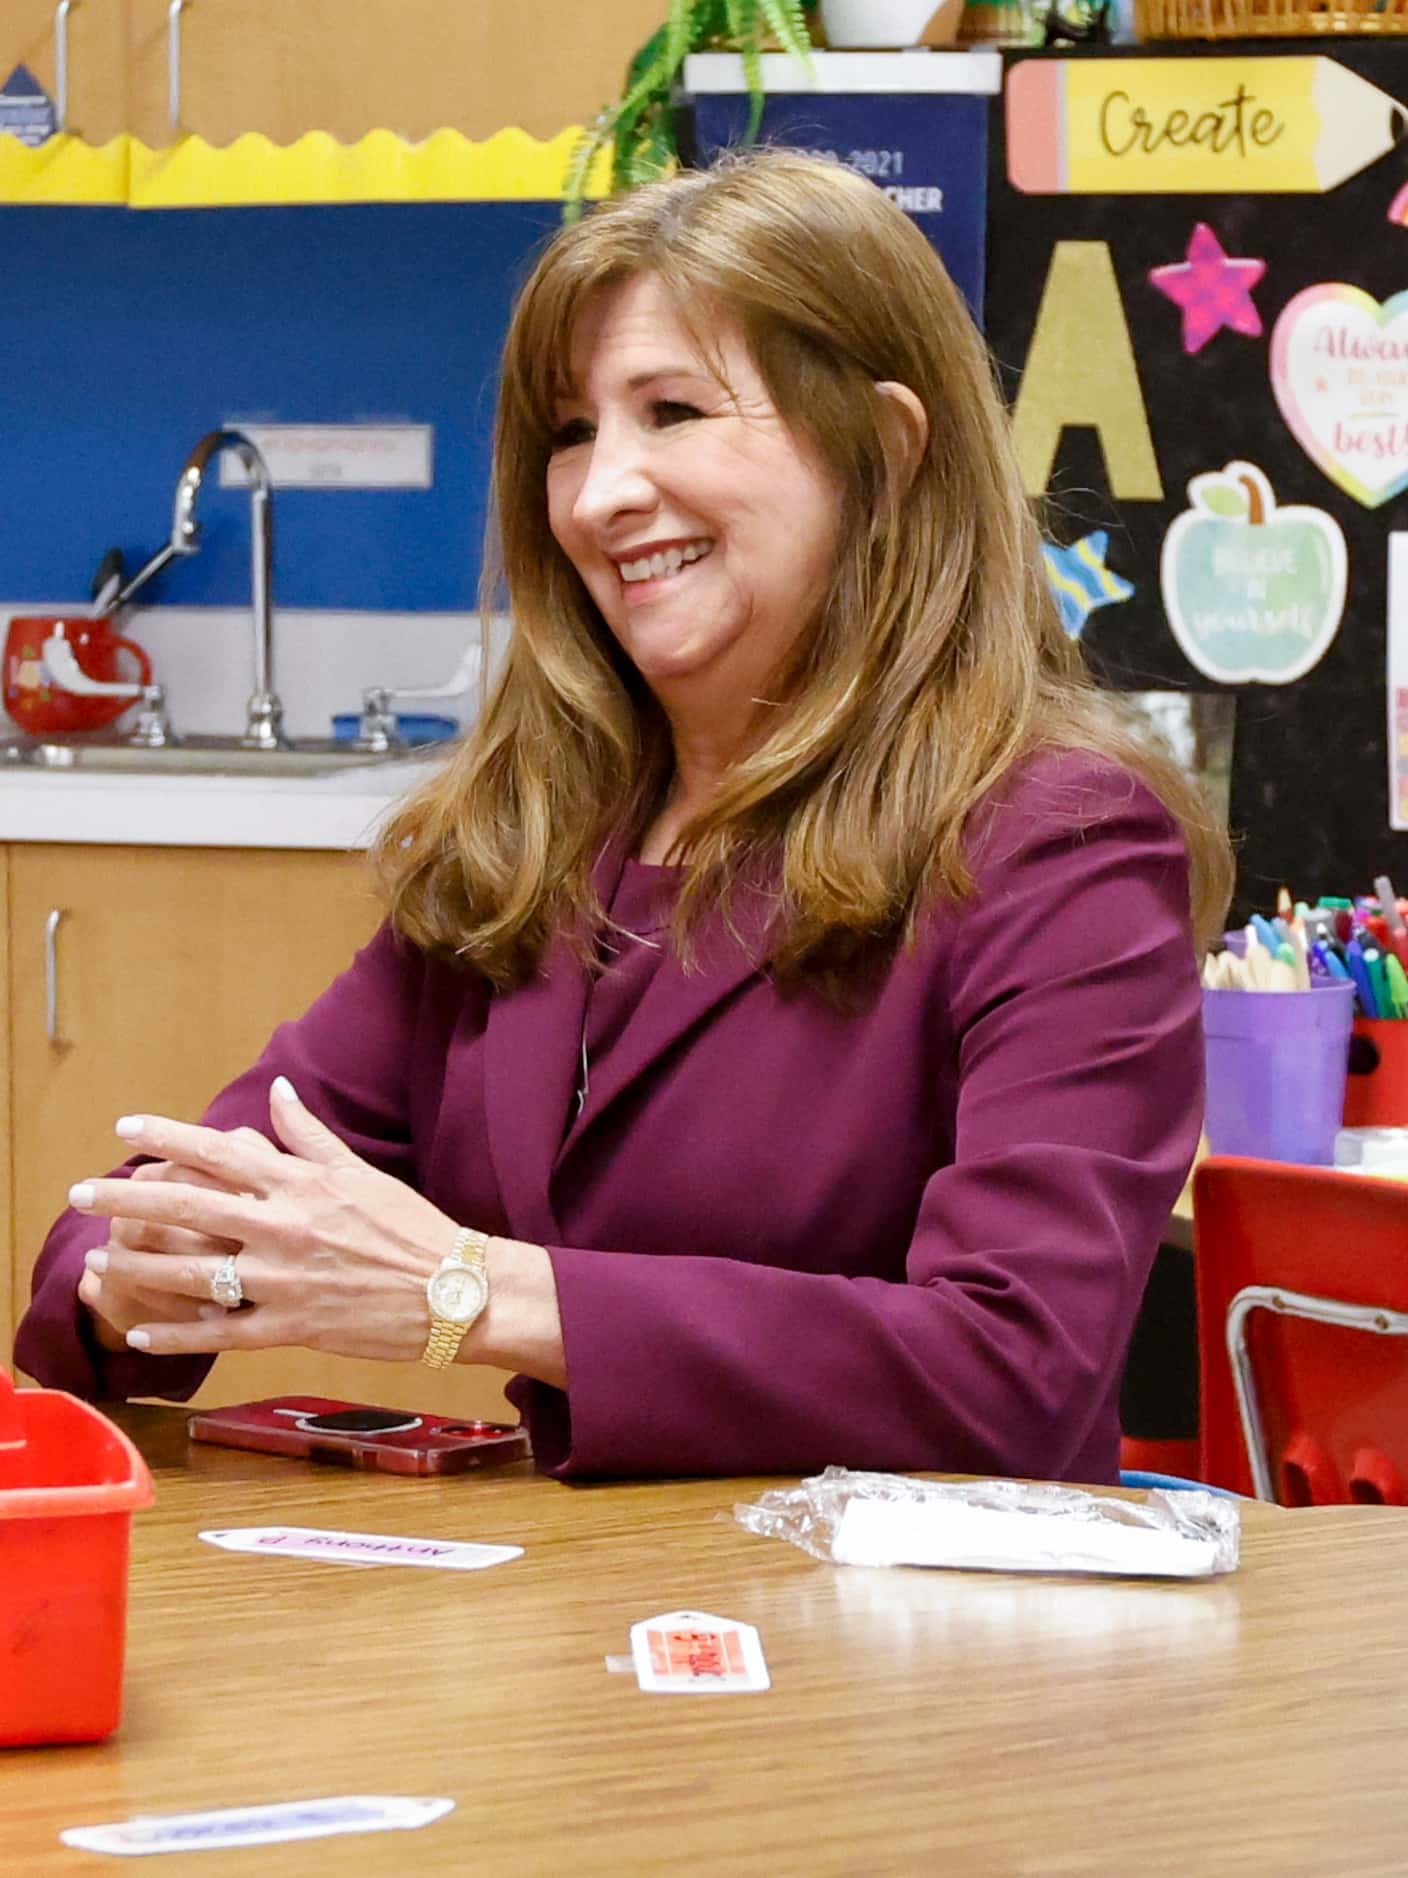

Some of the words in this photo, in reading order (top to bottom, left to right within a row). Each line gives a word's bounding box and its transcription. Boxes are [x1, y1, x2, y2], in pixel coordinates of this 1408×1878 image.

[1098, 82, 1285, 159] Create
[883, 185, 944, 212] CHER
[1010, 240, 1165, 501] A
